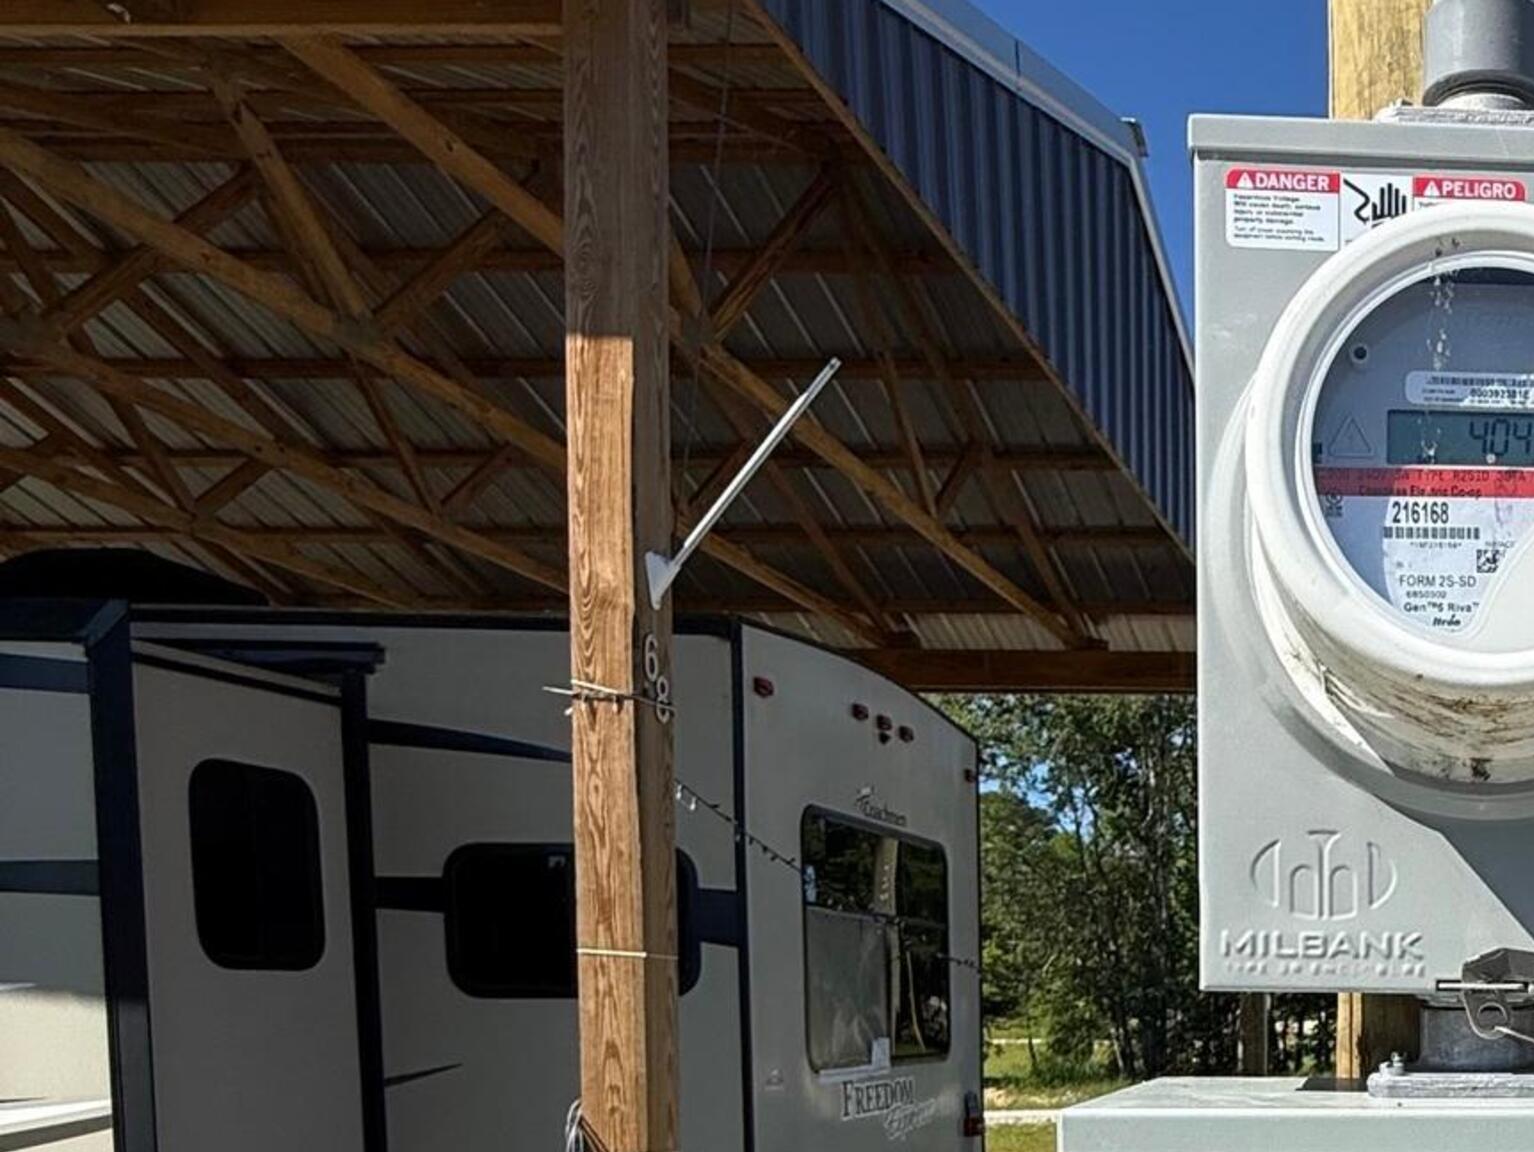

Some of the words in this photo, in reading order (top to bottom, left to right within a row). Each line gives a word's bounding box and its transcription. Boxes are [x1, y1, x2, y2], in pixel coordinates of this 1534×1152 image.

[1255, 172, 1331, 191] DANGER
[1441, 180, 1516, 198] PELIGRO
[1392, 501, 1449, 523] 216168
[1399, 574, 1436, 588] FORM
[1438, 574, 1477, 588] 2S-SD
[1219, 929, 1425, 963] MILBANK
